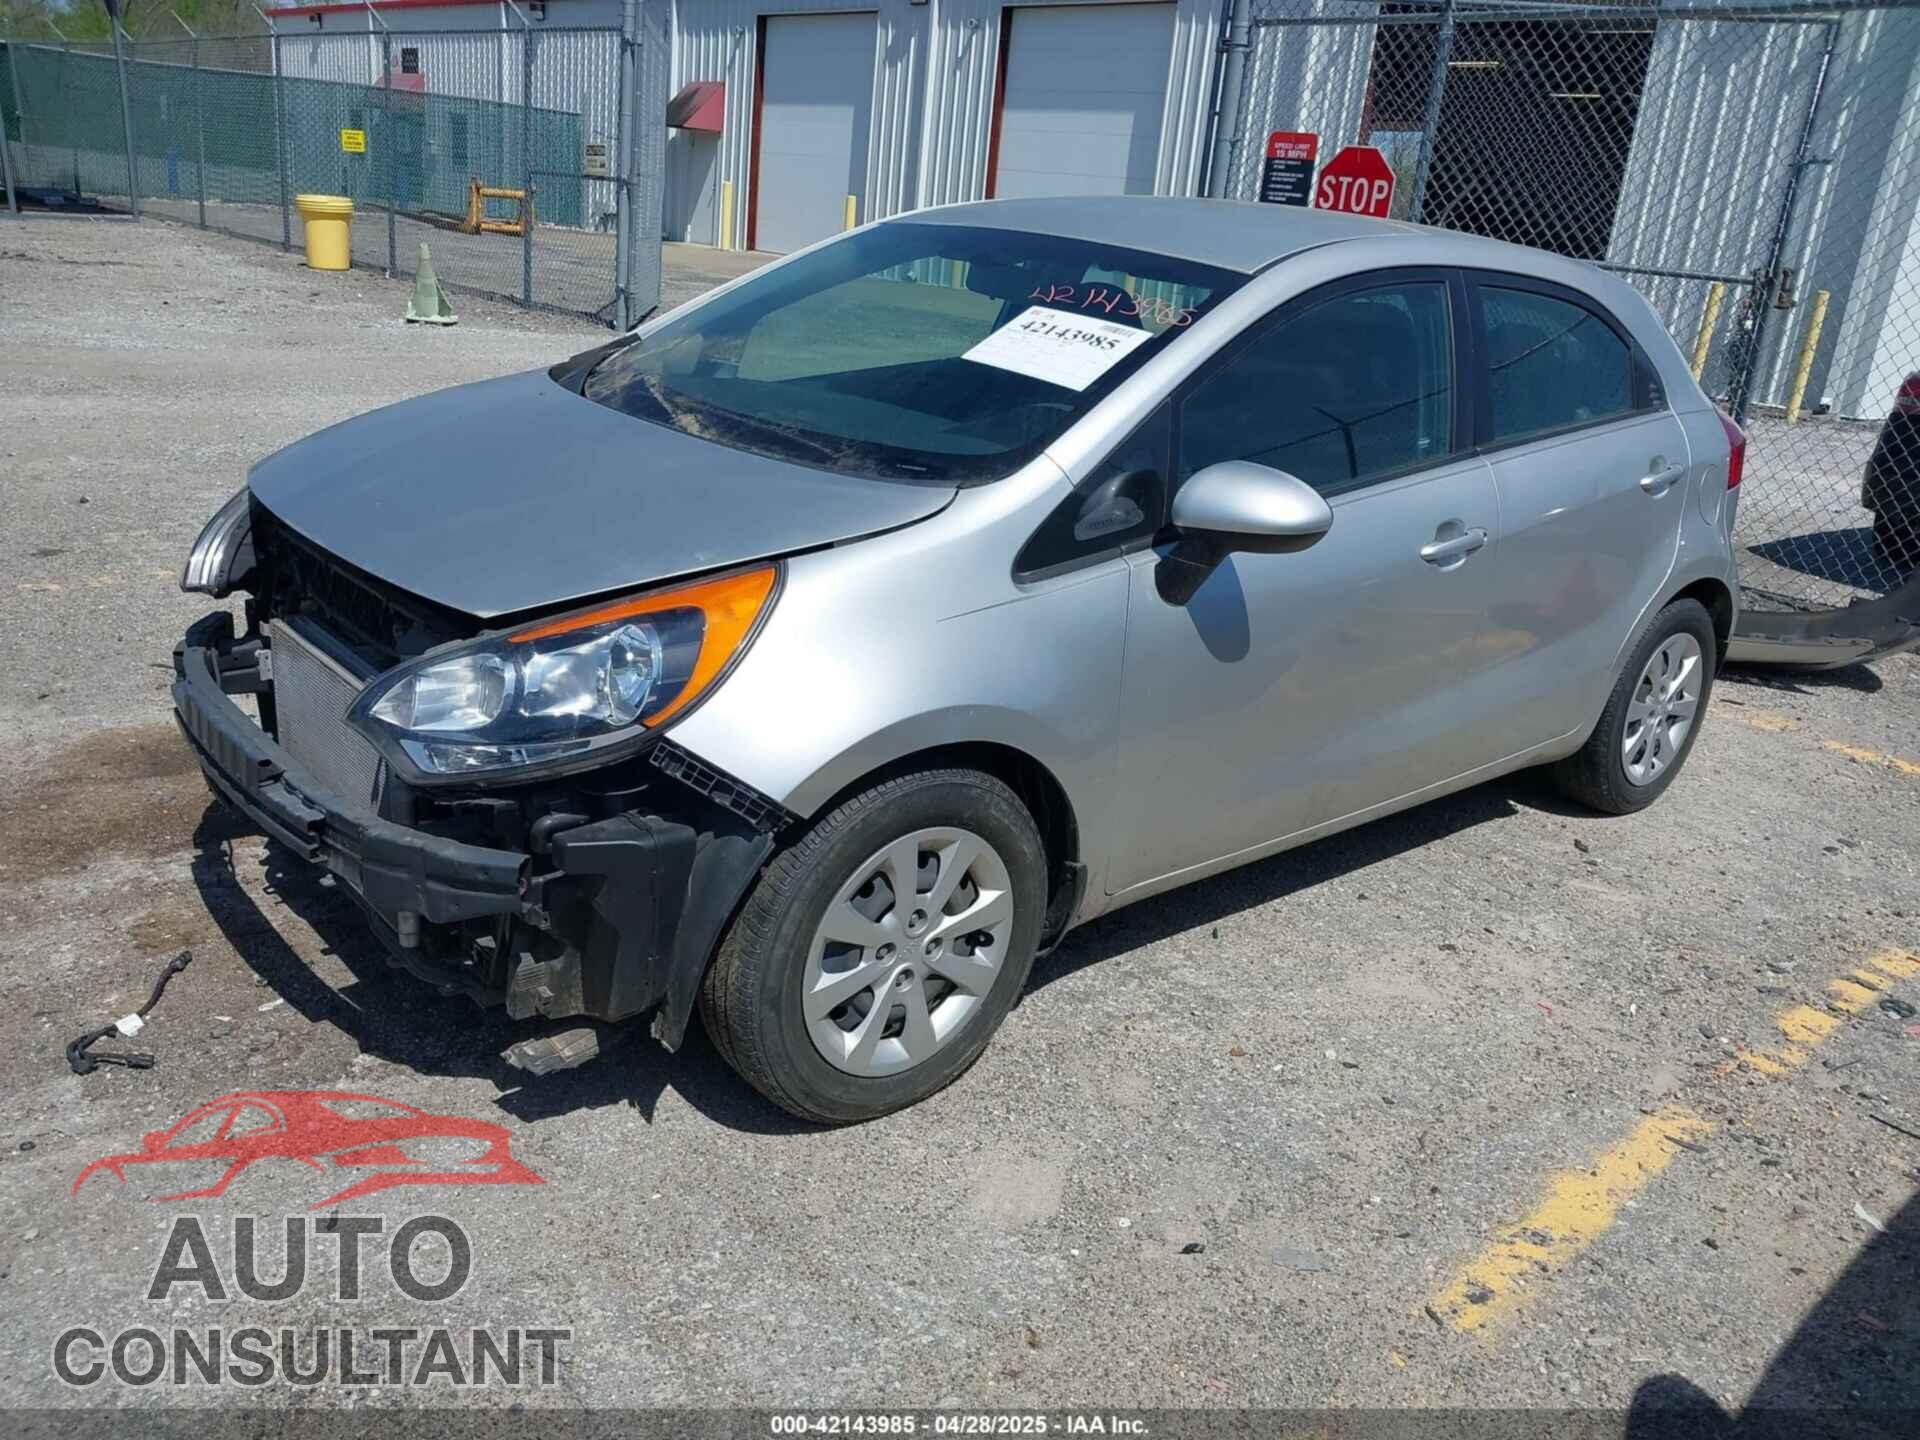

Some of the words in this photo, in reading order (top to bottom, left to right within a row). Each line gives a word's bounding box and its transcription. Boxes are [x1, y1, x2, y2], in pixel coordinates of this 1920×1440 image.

[1277, 150, 1285, 158] 15
[1288, 150, 1307, 159] MPH
[1319, 175, 1389, 213] STOP
[1020, 320, 1121, 351] 42143985
